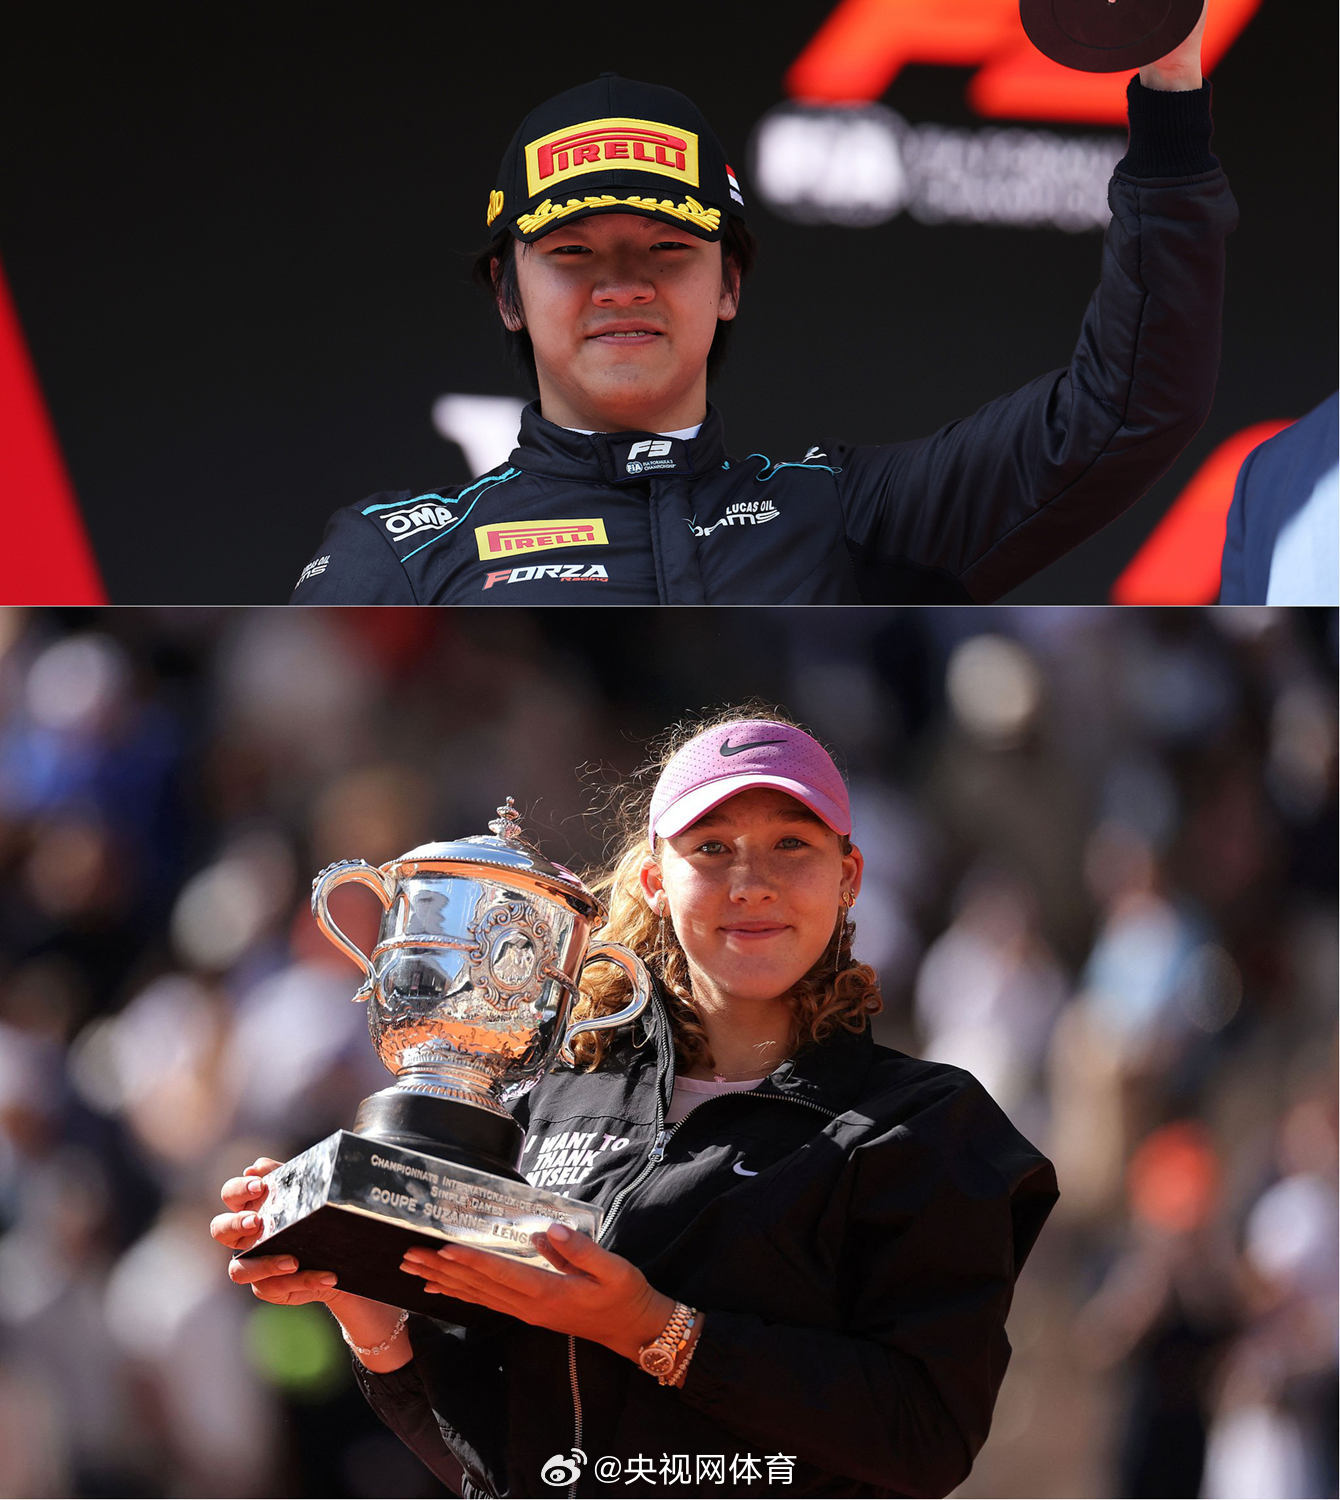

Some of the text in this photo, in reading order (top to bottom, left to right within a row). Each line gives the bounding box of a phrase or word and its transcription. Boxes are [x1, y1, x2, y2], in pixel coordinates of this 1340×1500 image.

[537, 127, 687, 180] PIRELLI
[627, 440, 673, 460] F3
[385, 505, 452, 535] OMP
[725, 500, 775, 515] LUCAS OIL
[486, 524, 595, 553] PIRELLI
[482, 564, 609, 591] FORZA
[524, 1131, 630, 1154] I WANT TO
[532, 1149, 601, 1172] THANK
[525, 1166, 594, 1188] MYSELF
[370, 1187, 418, 1212] COUPE
[424, 1203, 488, 1233] SUZANNE
